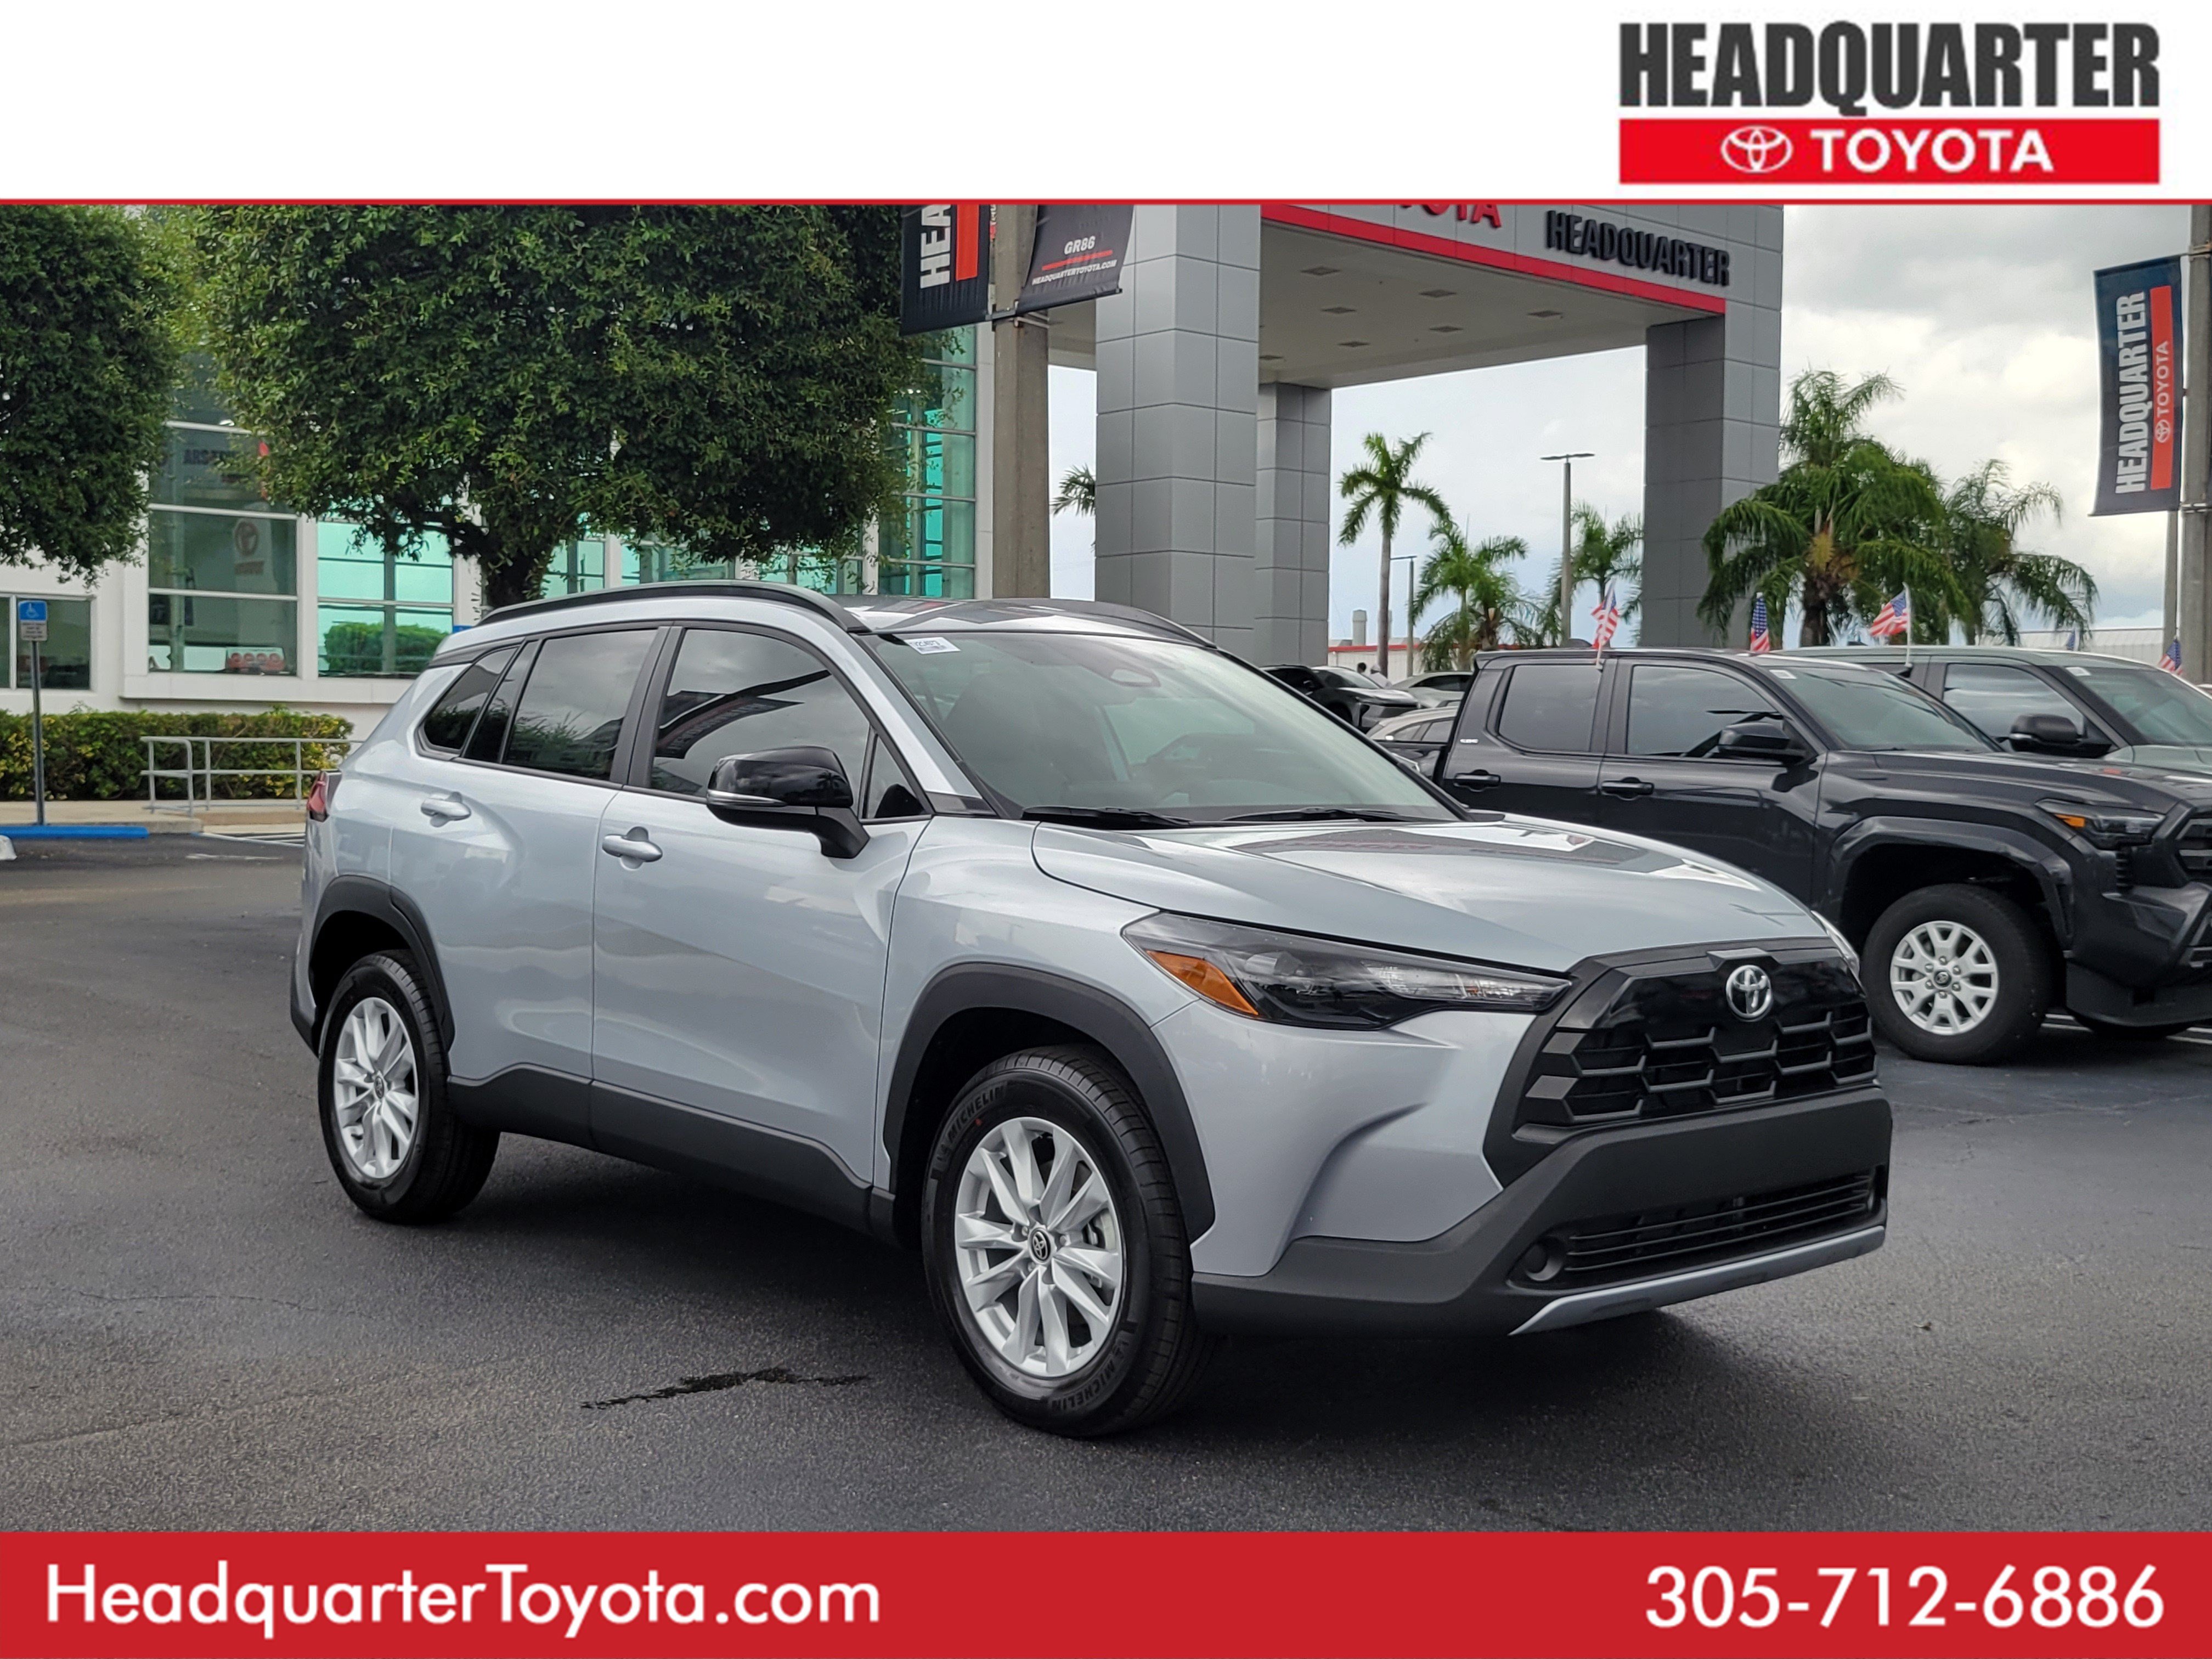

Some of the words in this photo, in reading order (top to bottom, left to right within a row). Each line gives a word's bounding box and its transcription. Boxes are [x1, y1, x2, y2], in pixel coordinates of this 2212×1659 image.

[1031, 259, 1118, 286] HEADQUARTERTOYOTA.COM
[1064, 235, 1096, 255] GR86
[1545, 210, 1730, 287] HEADQUARTER
[2115, 291, 2153, 494] HEADQUARTER
[2156, 340, 2171, 418] TOYOTA
[947, 1081, 1008, 1143] MICHELIN
